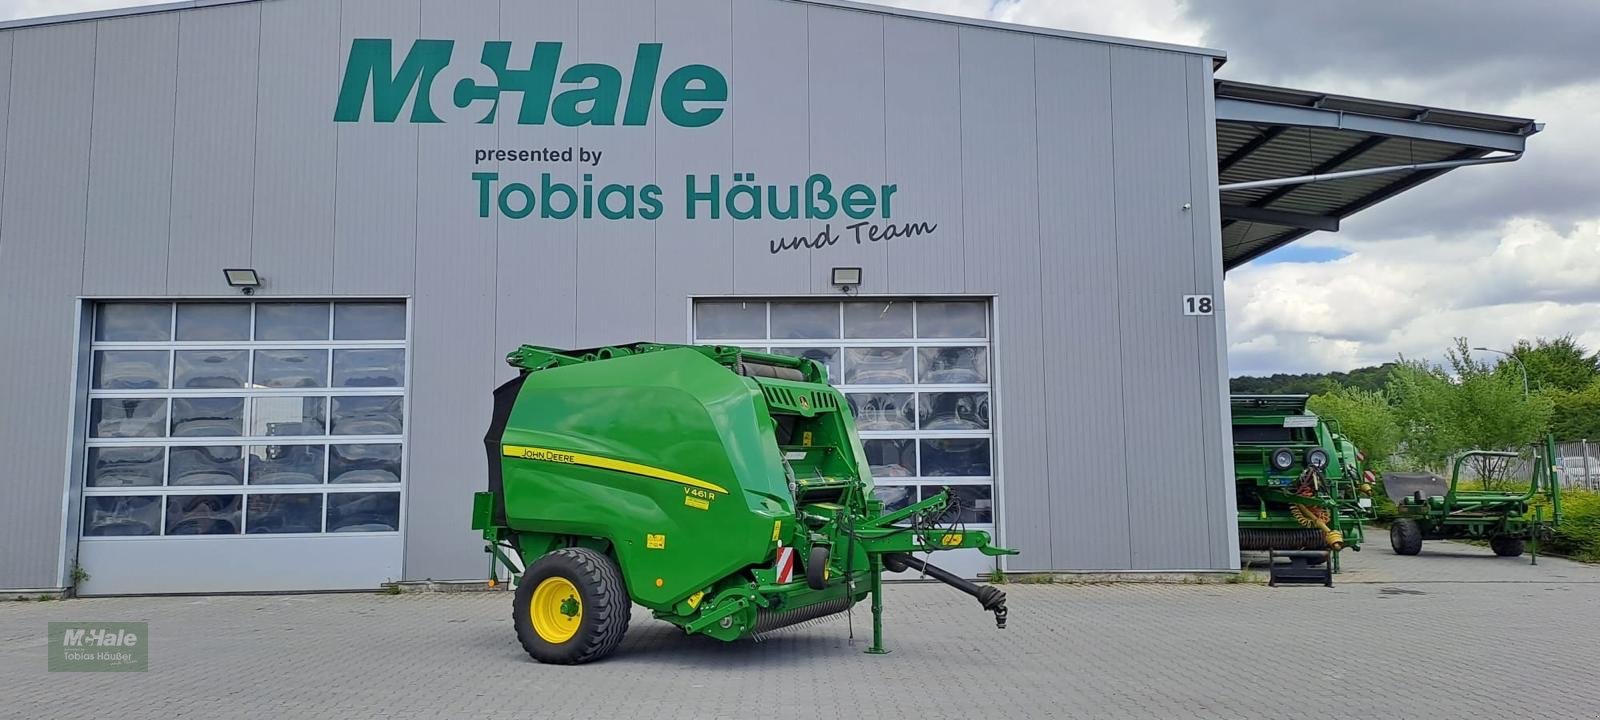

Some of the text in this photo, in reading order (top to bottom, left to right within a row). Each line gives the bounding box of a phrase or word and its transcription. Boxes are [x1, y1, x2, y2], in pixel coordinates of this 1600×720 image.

[334, 38, 728, 128] McHale
[475, 146, 603, 167] presented by
[472, 172, 898, 221] Tobias Häußer
[769, 220, 938, 255] und Team
[1187, 297, 1212, 313] 18
[684, 486, 715, 501] V 461 R
